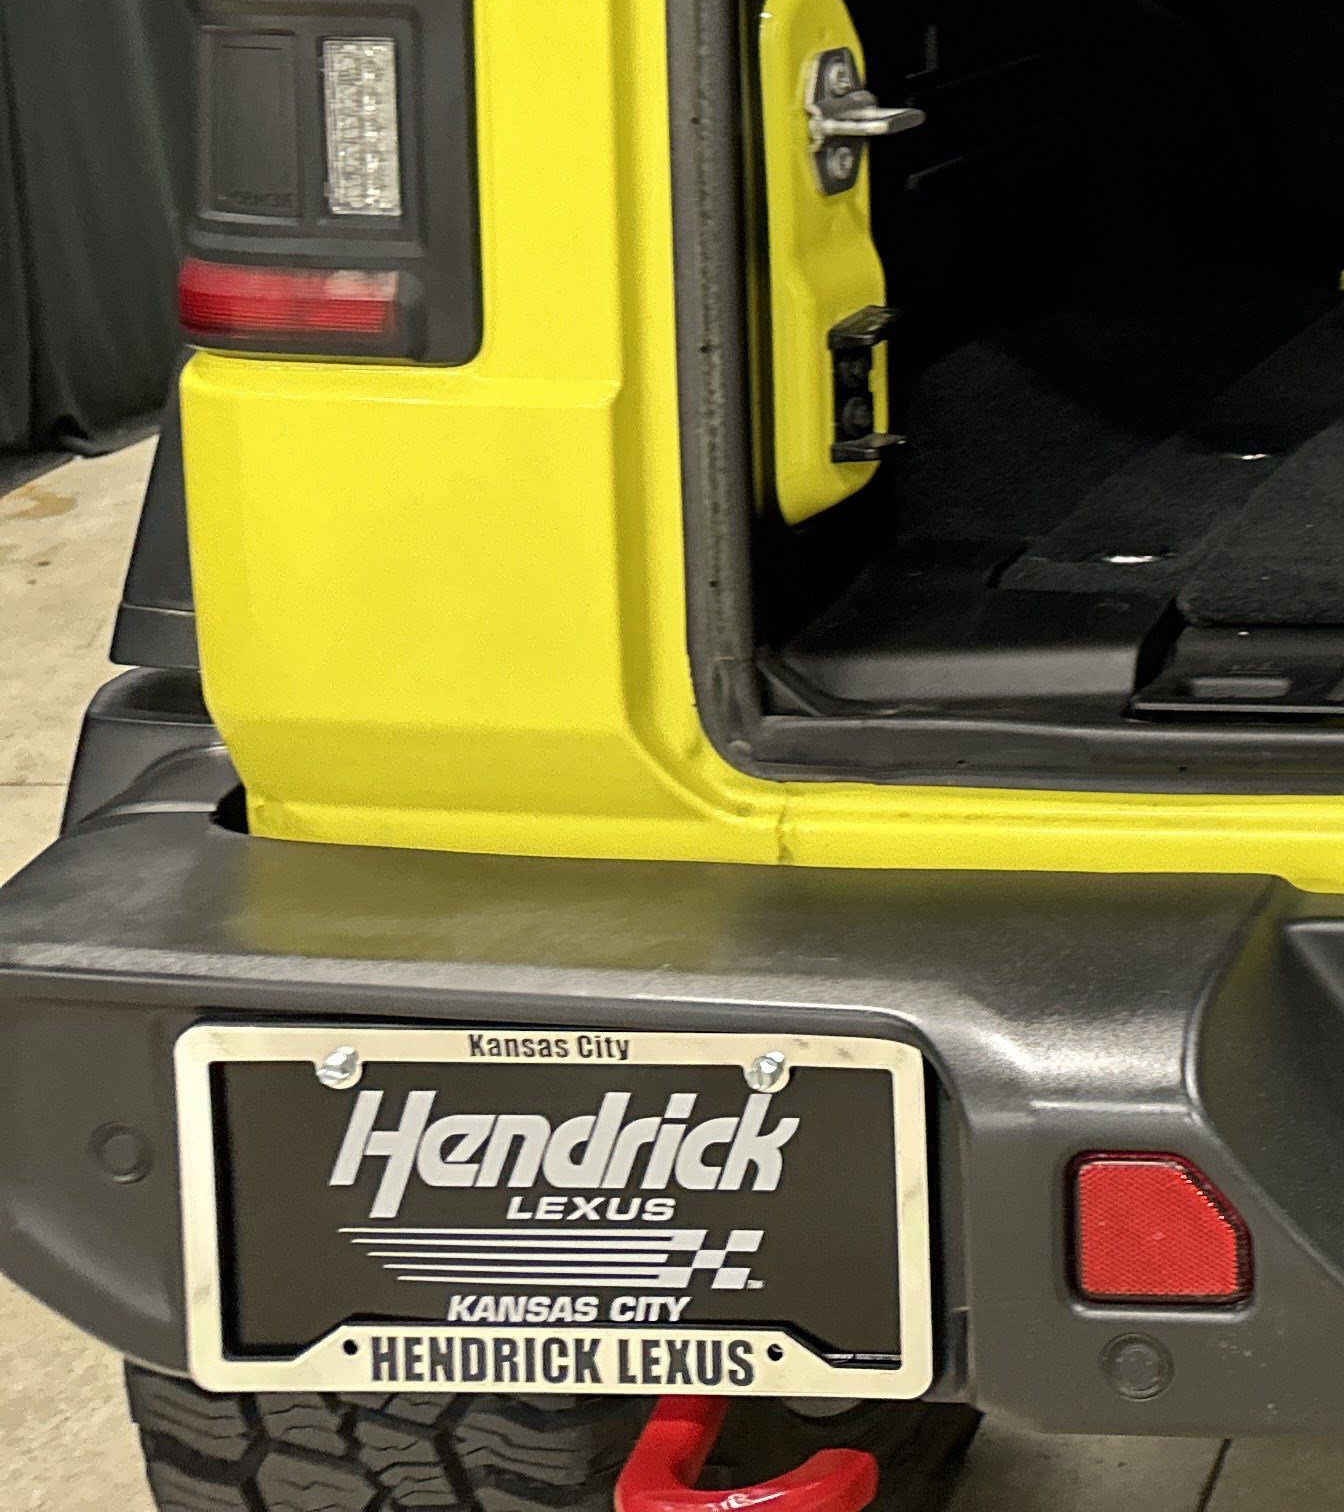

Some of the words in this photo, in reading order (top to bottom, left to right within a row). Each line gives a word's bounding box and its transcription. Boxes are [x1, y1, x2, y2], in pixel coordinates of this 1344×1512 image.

[469, 1032, 574, 1059] Kansas
[578, 1034, 630, 1062] City
[329, 1090, 800, 1219] Hendrick
[506, 1196, 676, 1221] LEXUS
[447, 1294, 600, 1323] KANSAS
[608, 1296, 694, 1324] CITY
[371, 1337, 605, 1385] HENDRICK
[618, 1339, 755, 1387] LEXUS
